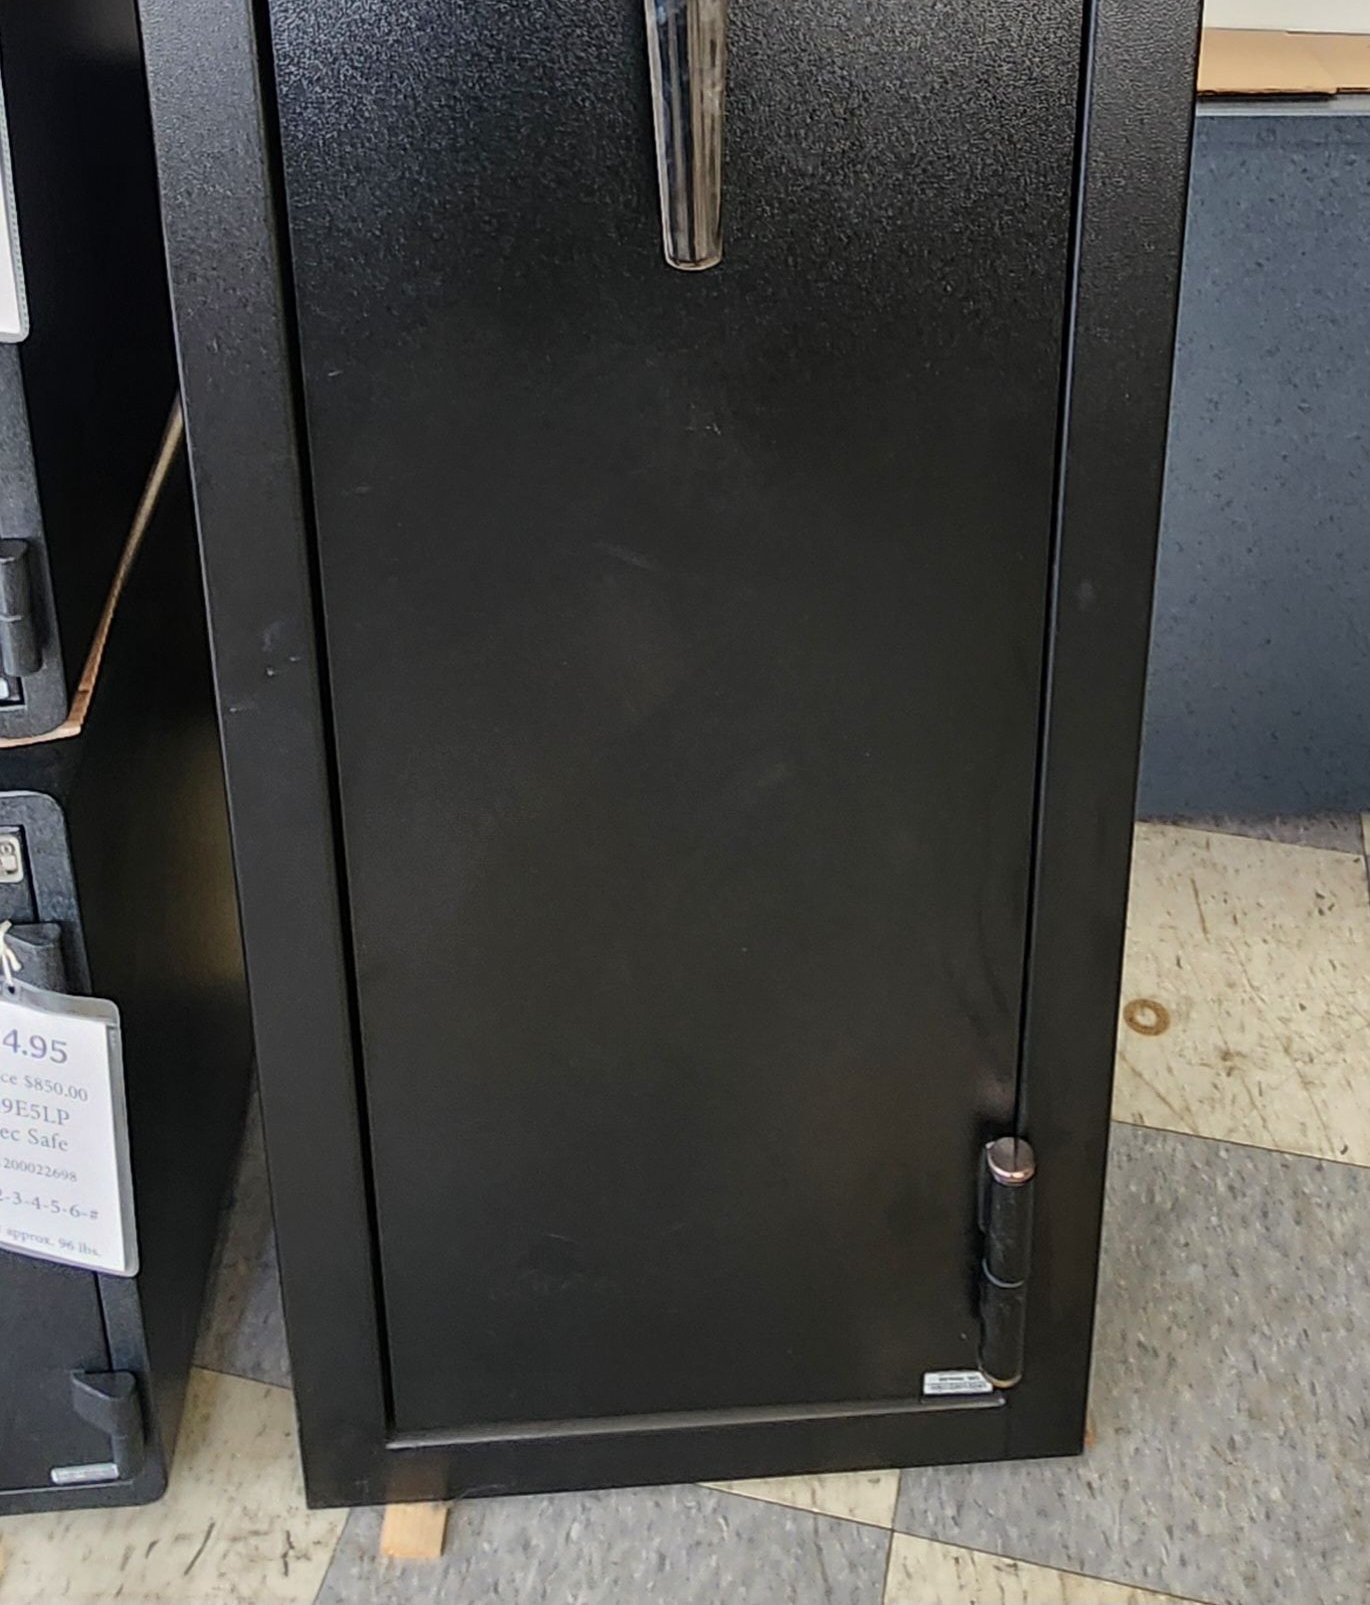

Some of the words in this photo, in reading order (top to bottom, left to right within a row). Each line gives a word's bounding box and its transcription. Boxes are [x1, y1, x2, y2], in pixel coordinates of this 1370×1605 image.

[2, 1028, 68, 1064] 4.95
[24, 1075, 88, 1102] $850.00
[1, 1097, 70, 1125] 9E5LP
[27, 1128, 69, 1152] Safe
